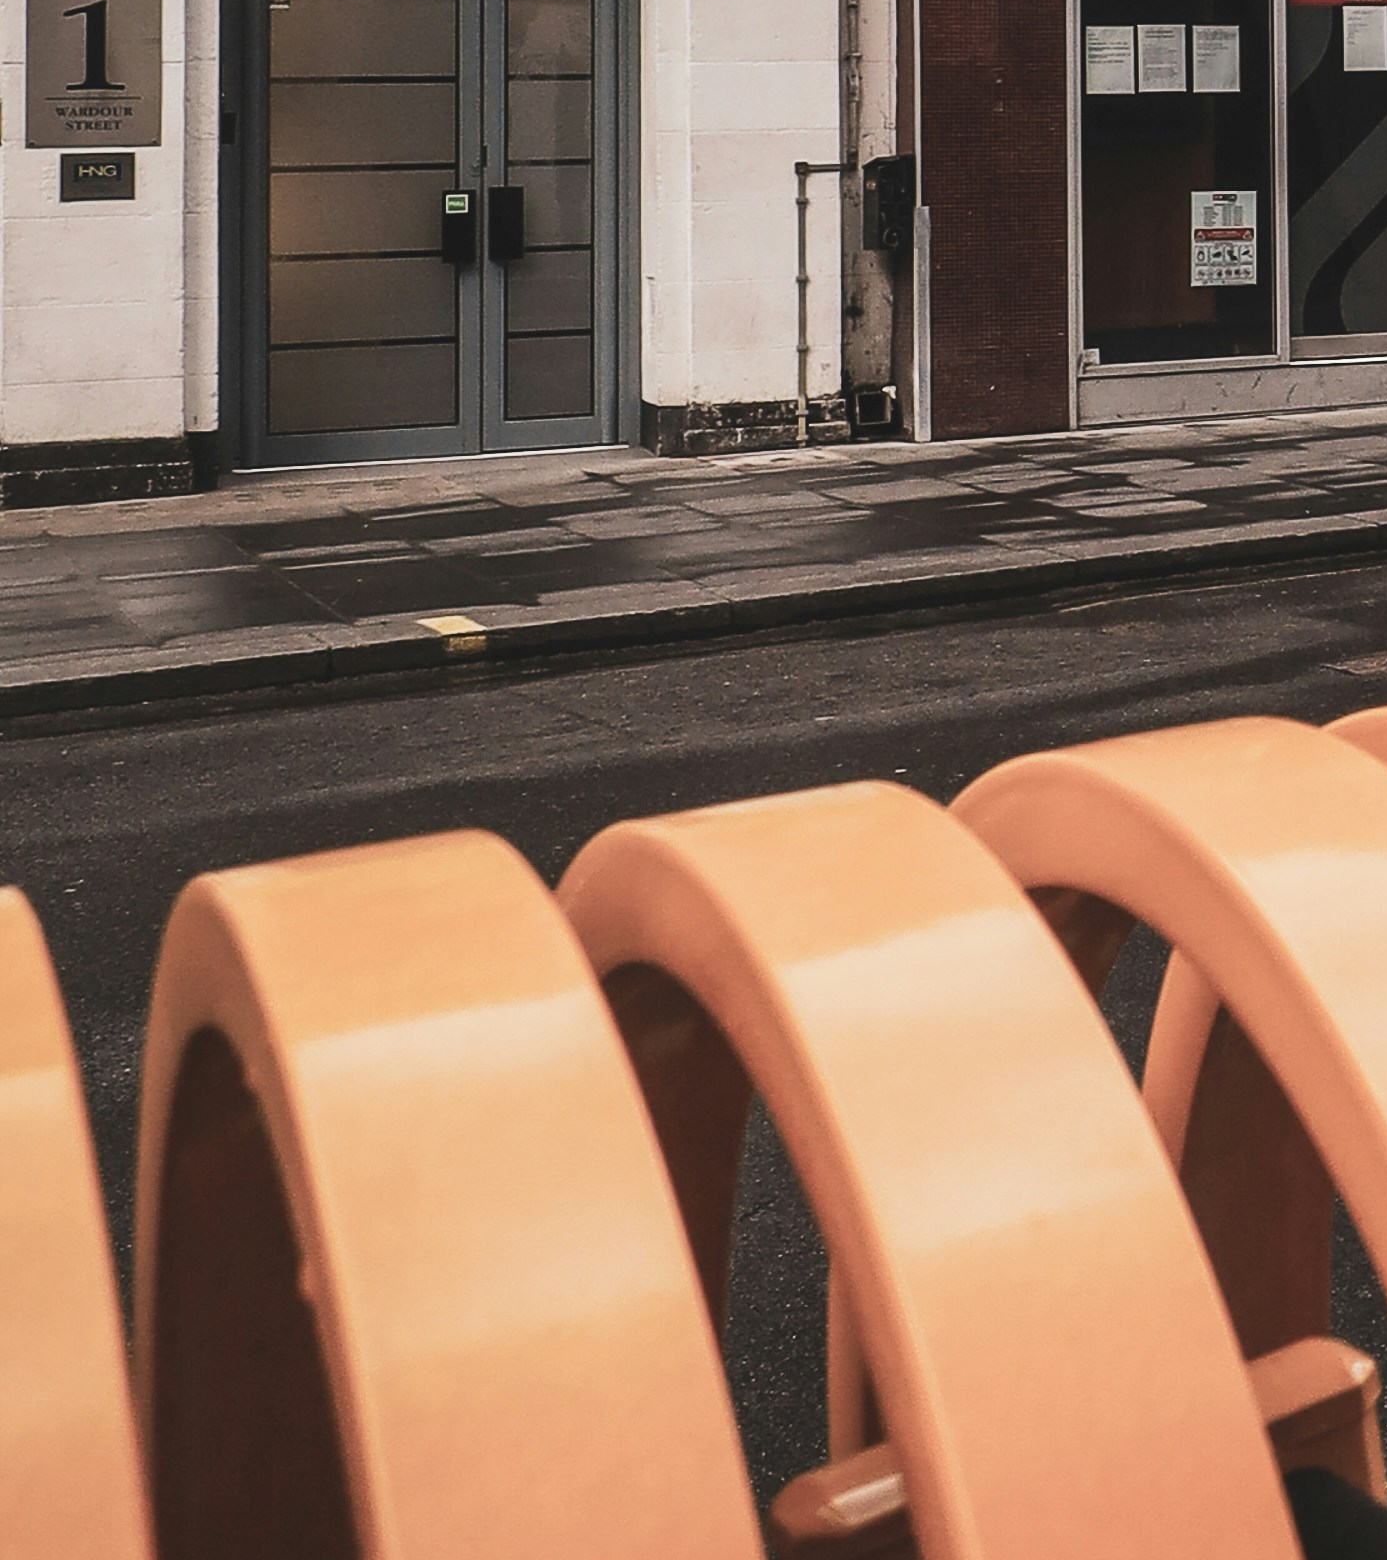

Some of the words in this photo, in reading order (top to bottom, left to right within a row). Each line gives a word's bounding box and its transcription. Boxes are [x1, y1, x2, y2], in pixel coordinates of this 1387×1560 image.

[62, 0, 126, 91] 1
[55, 106, 134, 118] WARDOUR
[64, 119, 123, 132] STREET
[78, 164, 117, 177] HNG
